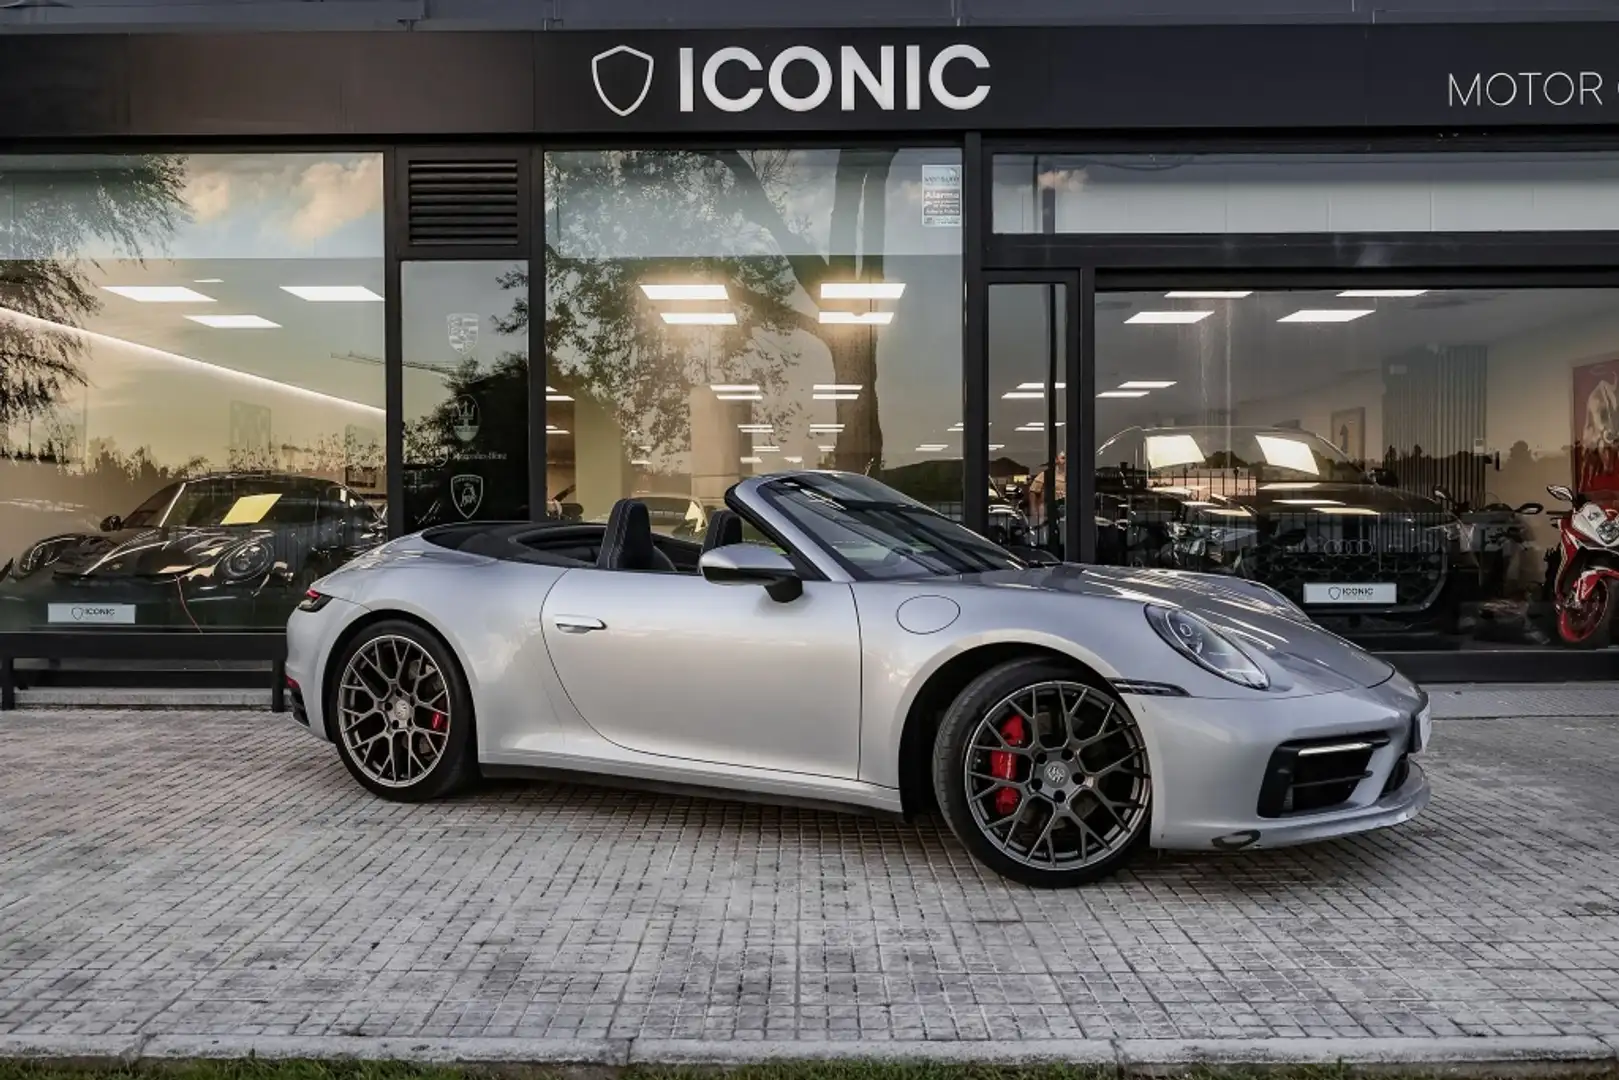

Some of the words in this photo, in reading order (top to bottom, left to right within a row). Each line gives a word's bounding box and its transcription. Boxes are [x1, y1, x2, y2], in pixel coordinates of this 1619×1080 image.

[679, 44, 991, 112] ICONIC
[1448, 72, 1603, 106] MOTOR
[1342, 587, 1374, 596] ICONIC
[85, 607, 115, 616] ICONIC
